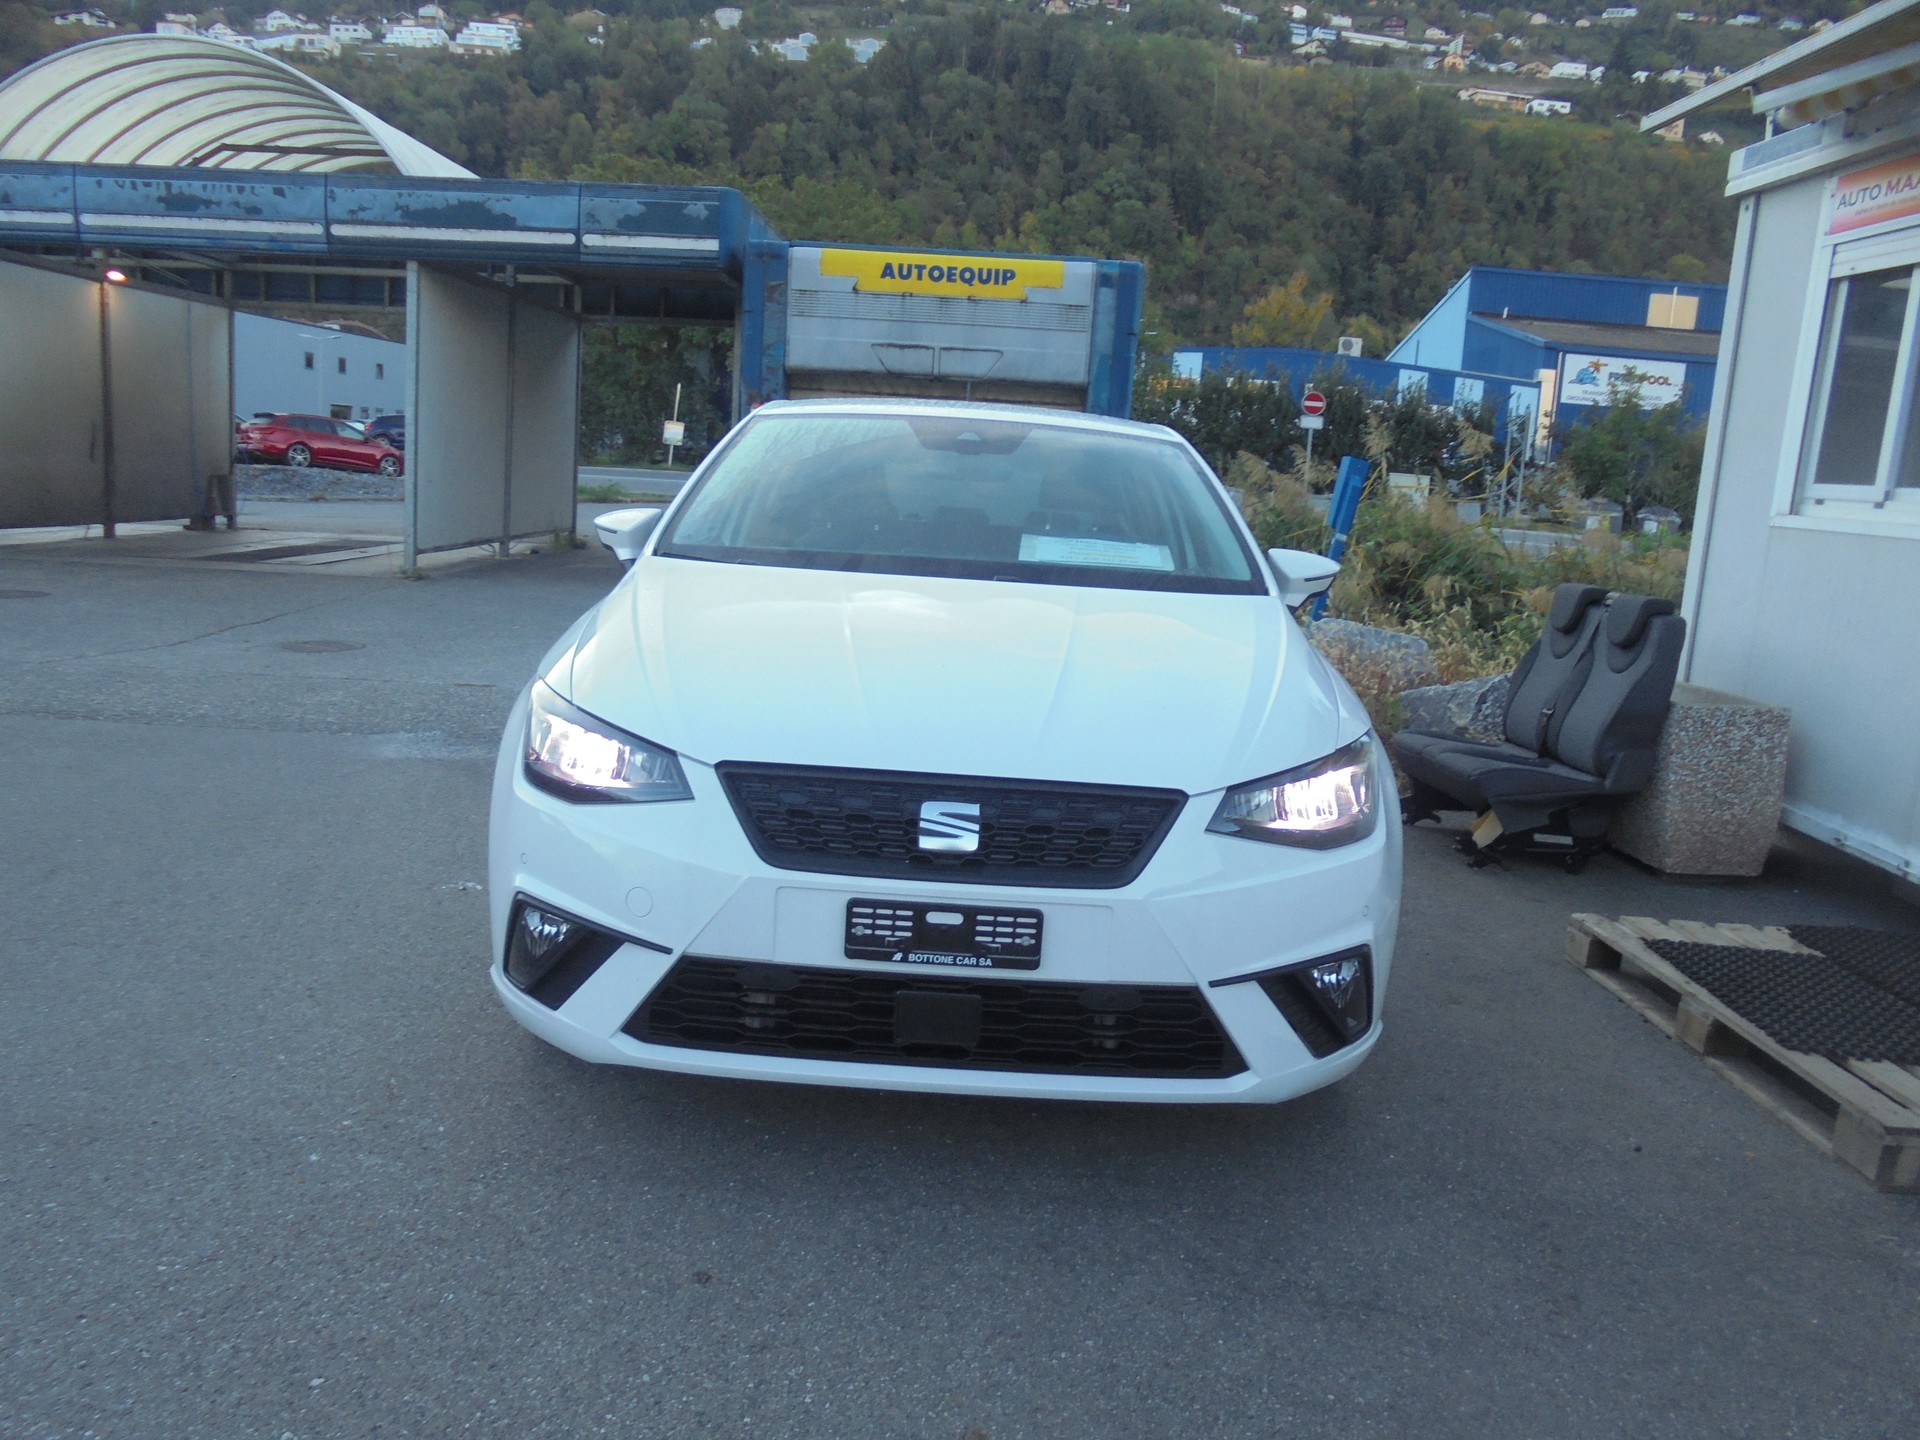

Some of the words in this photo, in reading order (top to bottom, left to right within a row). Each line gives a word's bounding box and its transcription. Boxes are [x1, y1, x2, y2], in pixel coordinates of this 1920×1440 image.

[1836, 183, 1882, 211] AUTO
[880, 262, 1017, 287] AUTOEQUIP
[908, 953, 955, 964] BOTTONE
[956, 956, 977, 966] CAR
[978, 958, 993, 967] SA
